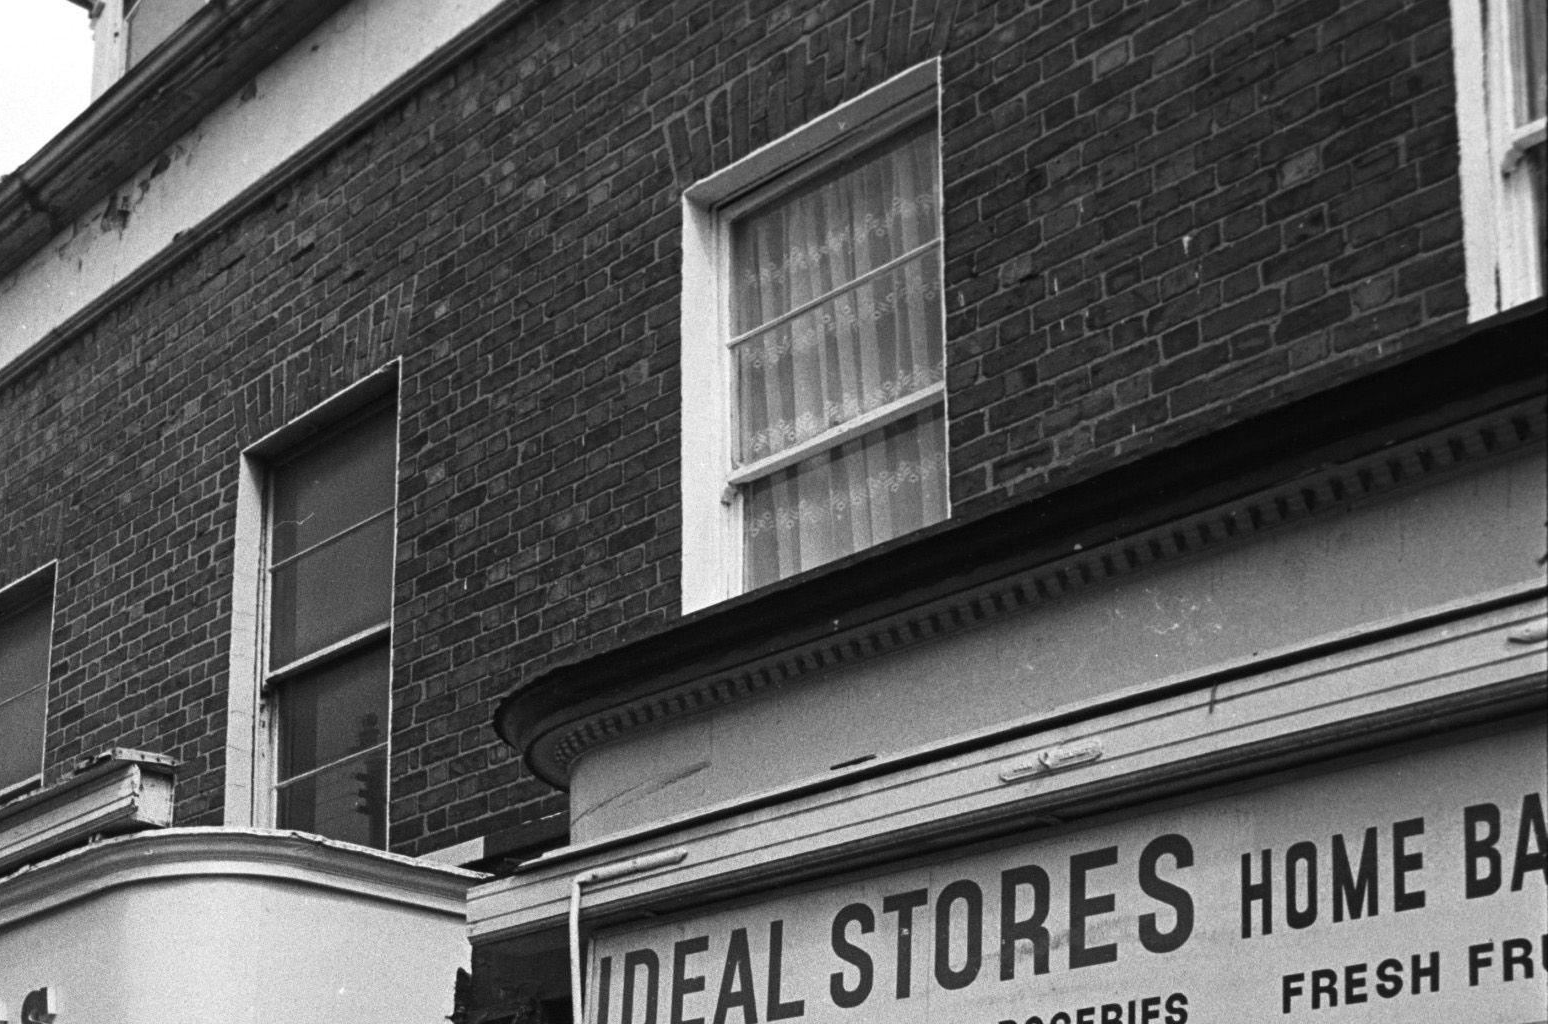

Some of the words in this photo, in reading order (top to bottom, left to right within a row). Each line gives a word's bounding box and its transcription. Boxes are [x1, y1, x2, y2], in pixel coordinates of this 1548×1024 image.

[829, 831, 1195, 1010] STORES
[1240, 816, 1426, 939] HOME
[1281, 950, 1440, 1014] FRESH
[1468, 933, 1548, 987] FR
